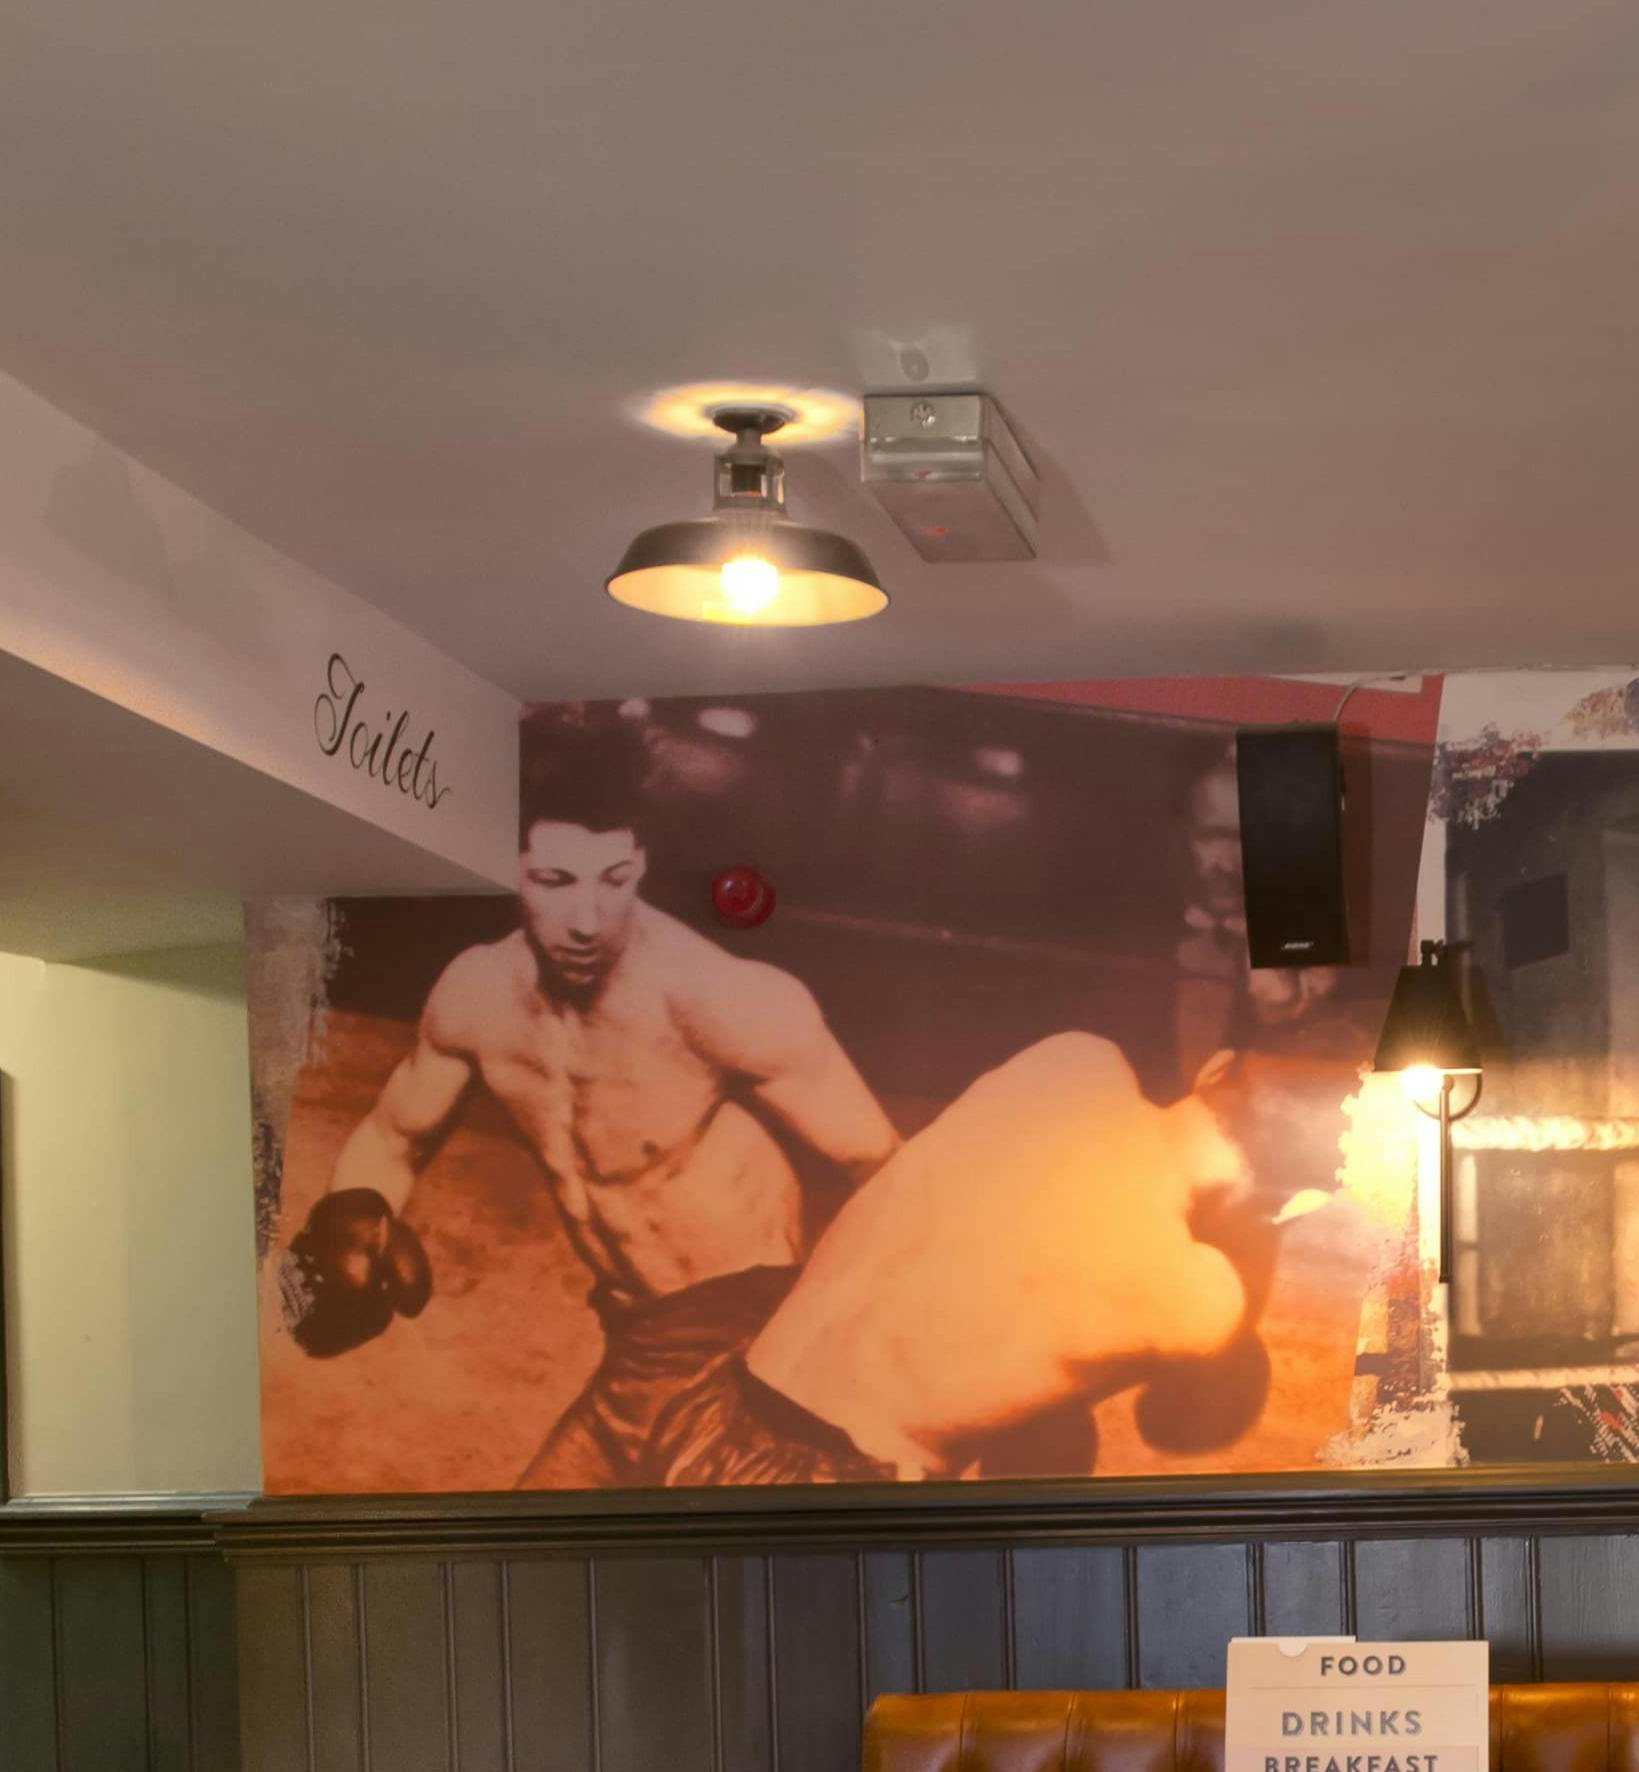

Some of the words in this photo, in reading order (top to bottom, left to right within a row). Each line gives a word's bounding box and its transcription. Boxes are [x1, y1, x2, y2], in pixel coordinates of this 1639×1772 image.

[314, 653, 450, 809] Toilets
[1320, 1655, 1407, 1676] FOOD
[1282, 1709, 1422, 1737] DRINKS
